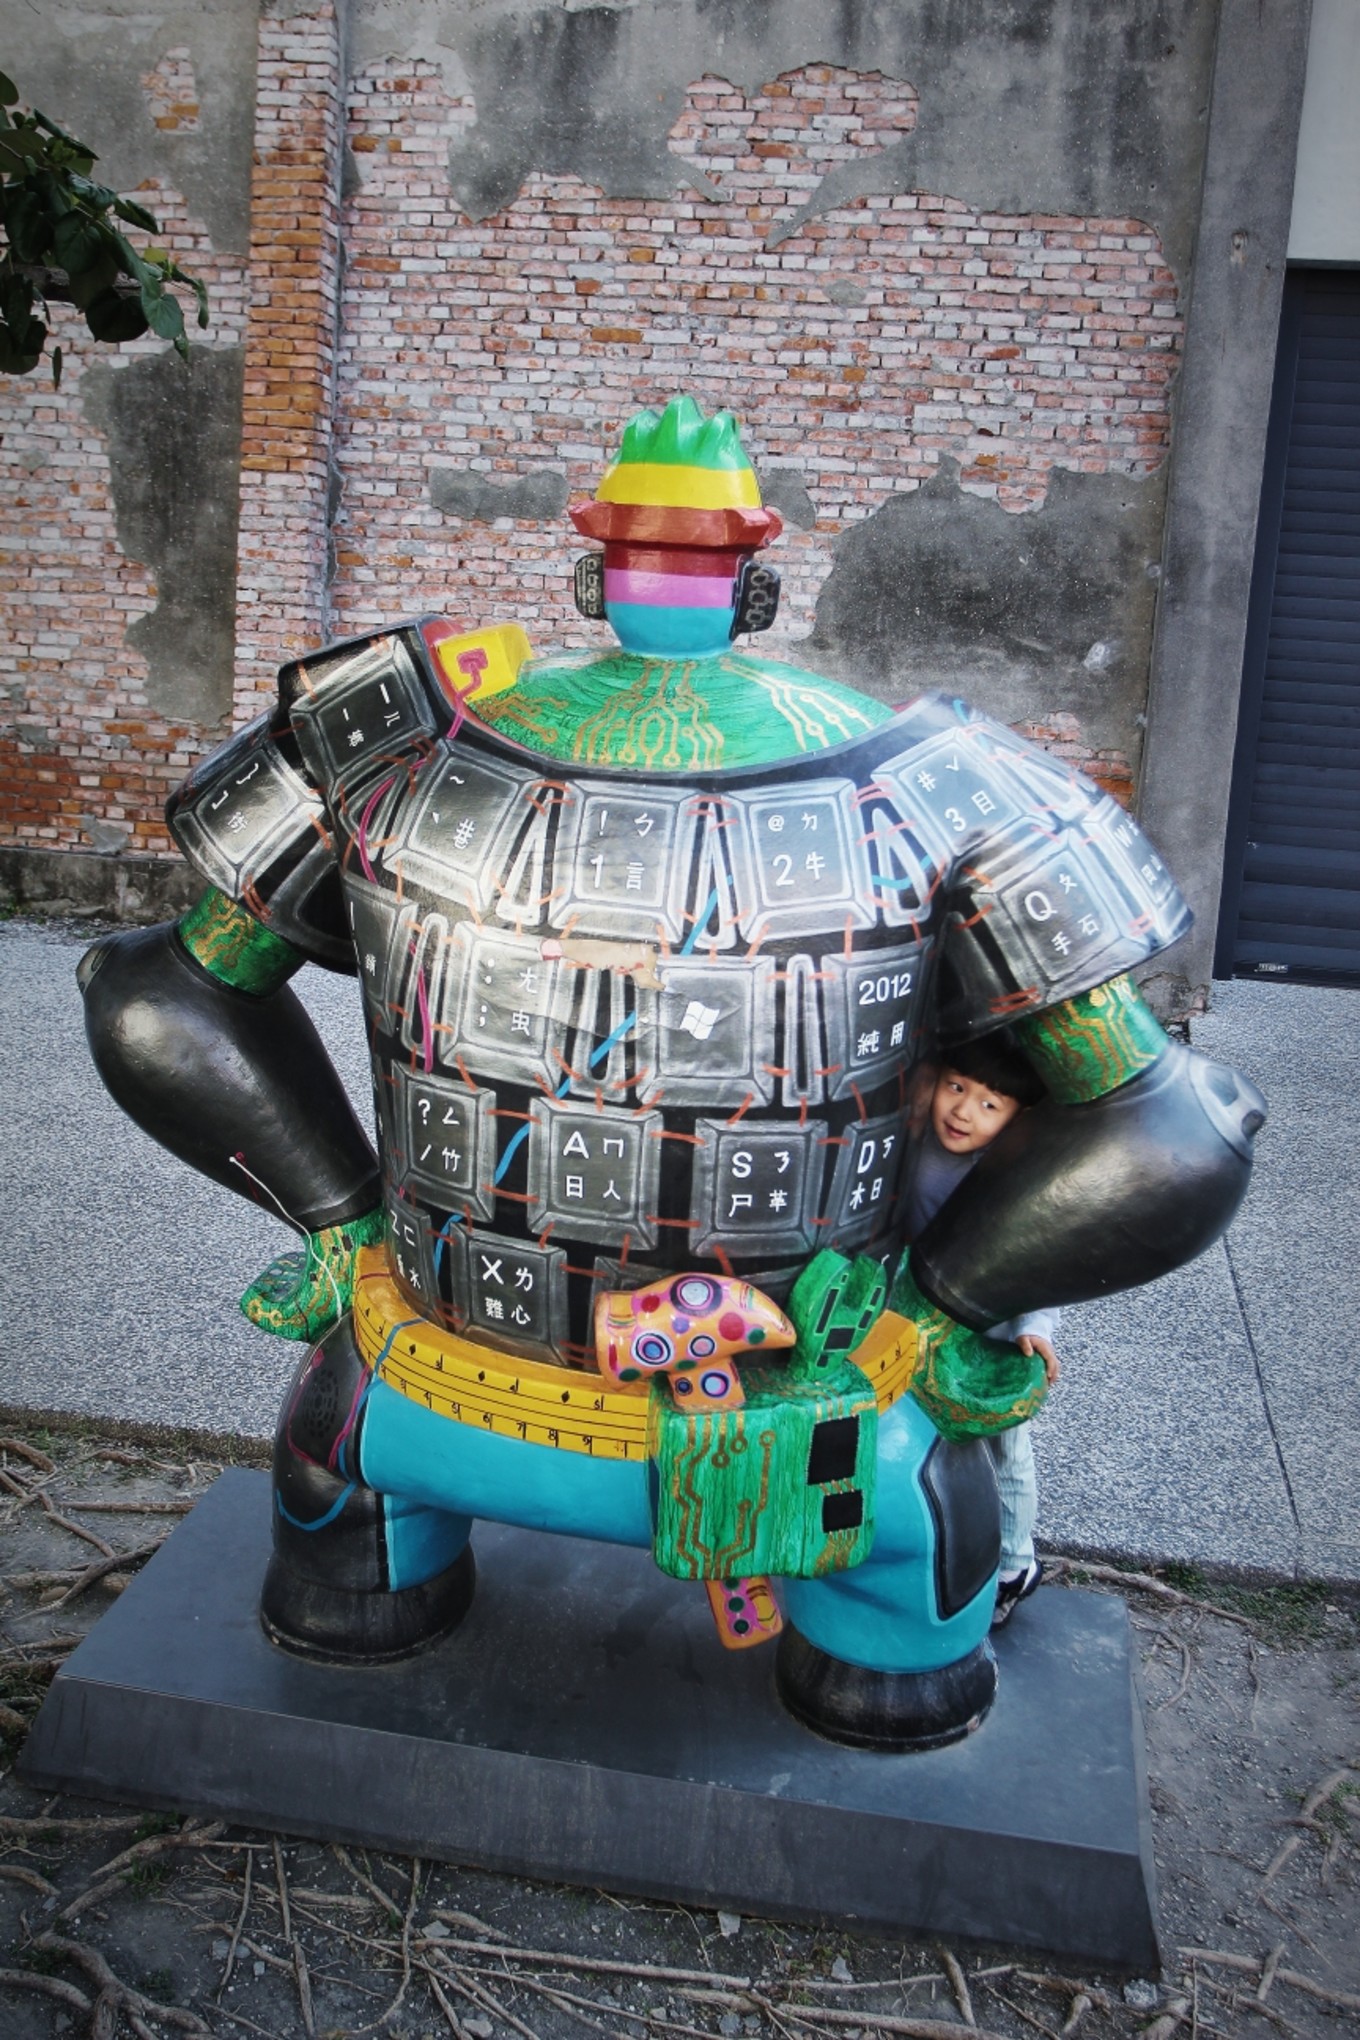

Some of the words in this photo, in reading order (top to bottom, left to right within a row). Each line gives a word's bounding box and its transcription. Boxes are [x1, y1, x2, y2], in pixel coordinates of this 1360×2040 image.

[917, 770, 936, 793] #
[599, 810, 608, 836] !
[767, 814, 785, 832] @
[945, 807, 967, 832] 3
[971, 790, 996, 816] 目
[590, 854, 604, 888] 1
[625, 862, 645, 890] 言
[772, 854, 795, 887] 2
[805, 851, 826, 880] 牛
[1024, 890, 1058, 922] Q
[1051, 931, 1073, 956] 手
[1077, 912, 1100, 936] 石
[858, 972, 912, 1006] 2012
[418, 1098, 431, 1126] ?
[441, 1146, 462, 1173] 竹
[562, 1130, 590, 1160] A
[857, 1140, 876, 1174] D
[731, 1151, 753, 1179] S
[566, 1175, 584, 1199] 日
[602, 1179, 622, 1201] 人
[849, 1181, 867, 1211] 木
[870, 1176, 884, 1202] 日
[480, 1254, 505, 1286] X
[510, 1303, 532, 1326] 心
